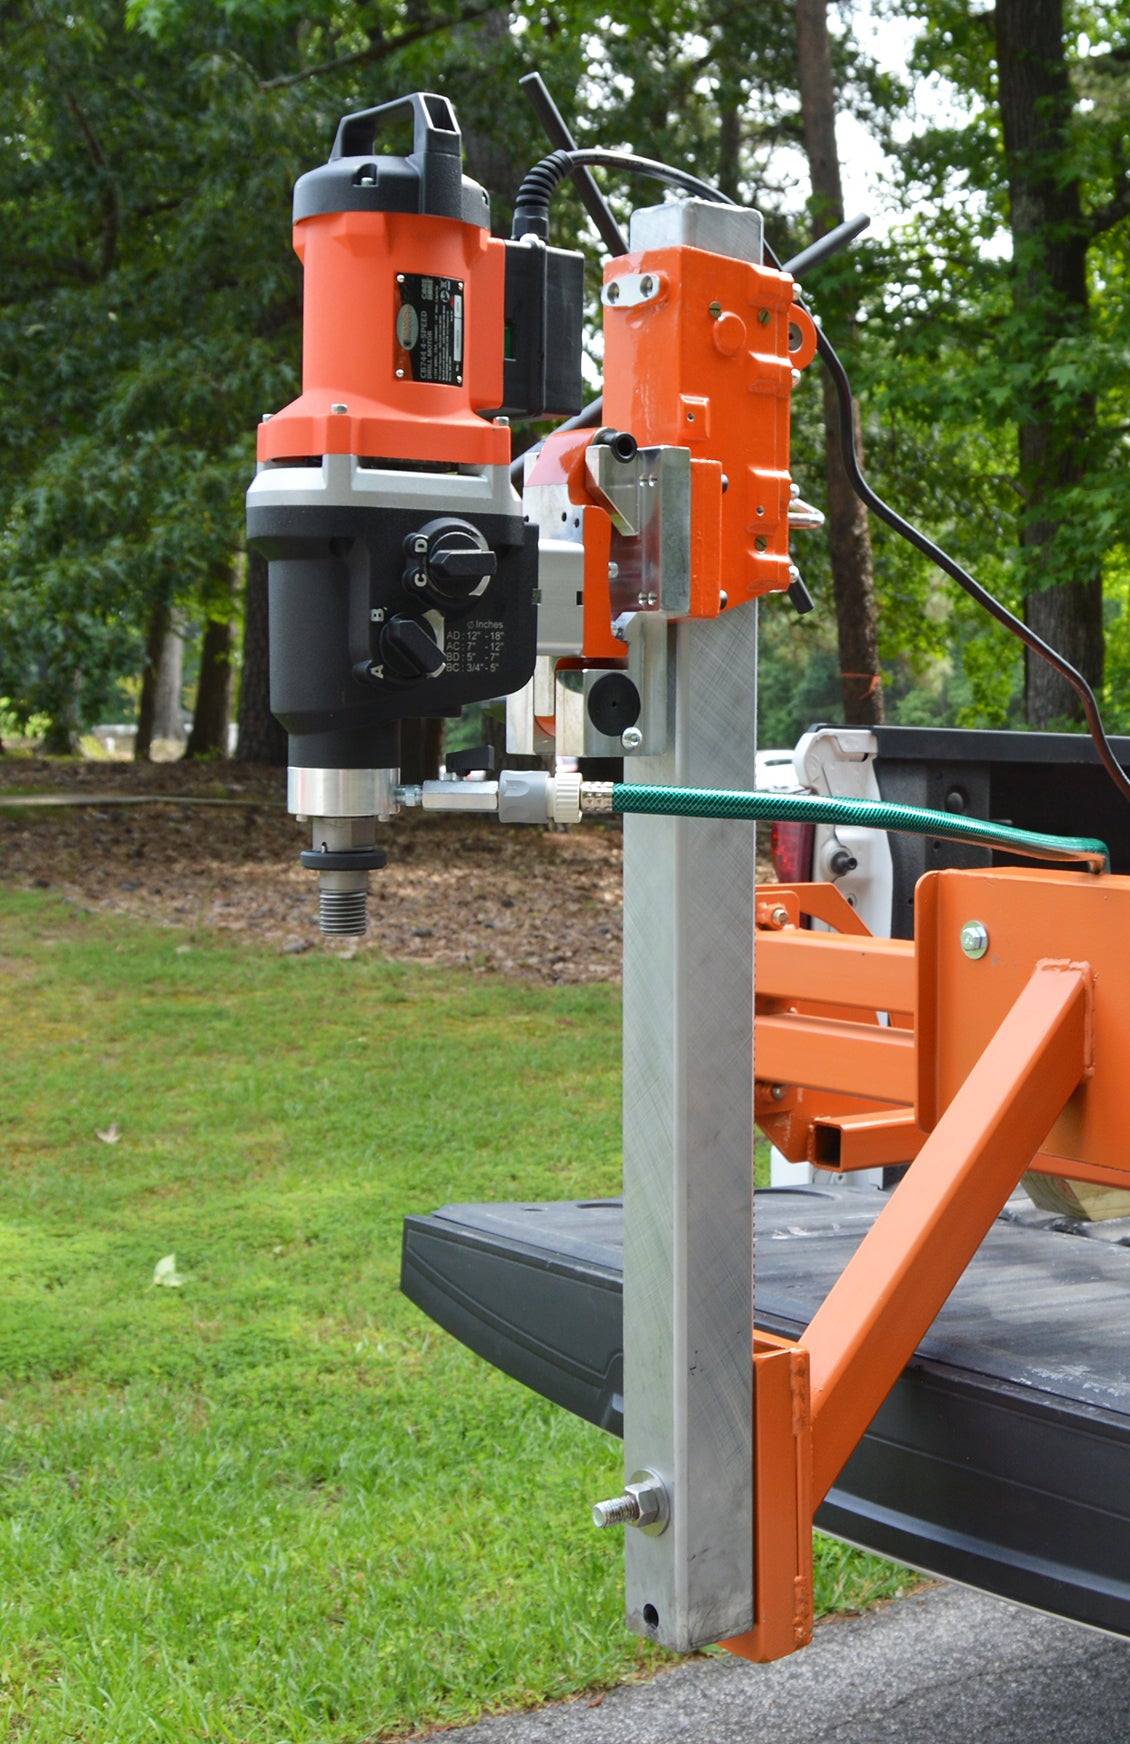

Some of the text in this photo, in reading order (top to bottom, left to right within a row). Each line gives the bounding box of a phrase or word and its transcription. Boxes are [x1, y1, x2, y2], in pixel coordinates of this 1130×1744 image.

[415, 538, 428, 553] D
[414, 573, 428, 587] C
[371, 608, 384, 622] B
[475, 620, 503, 629] Inches
[369, 664, 384, 679] A
